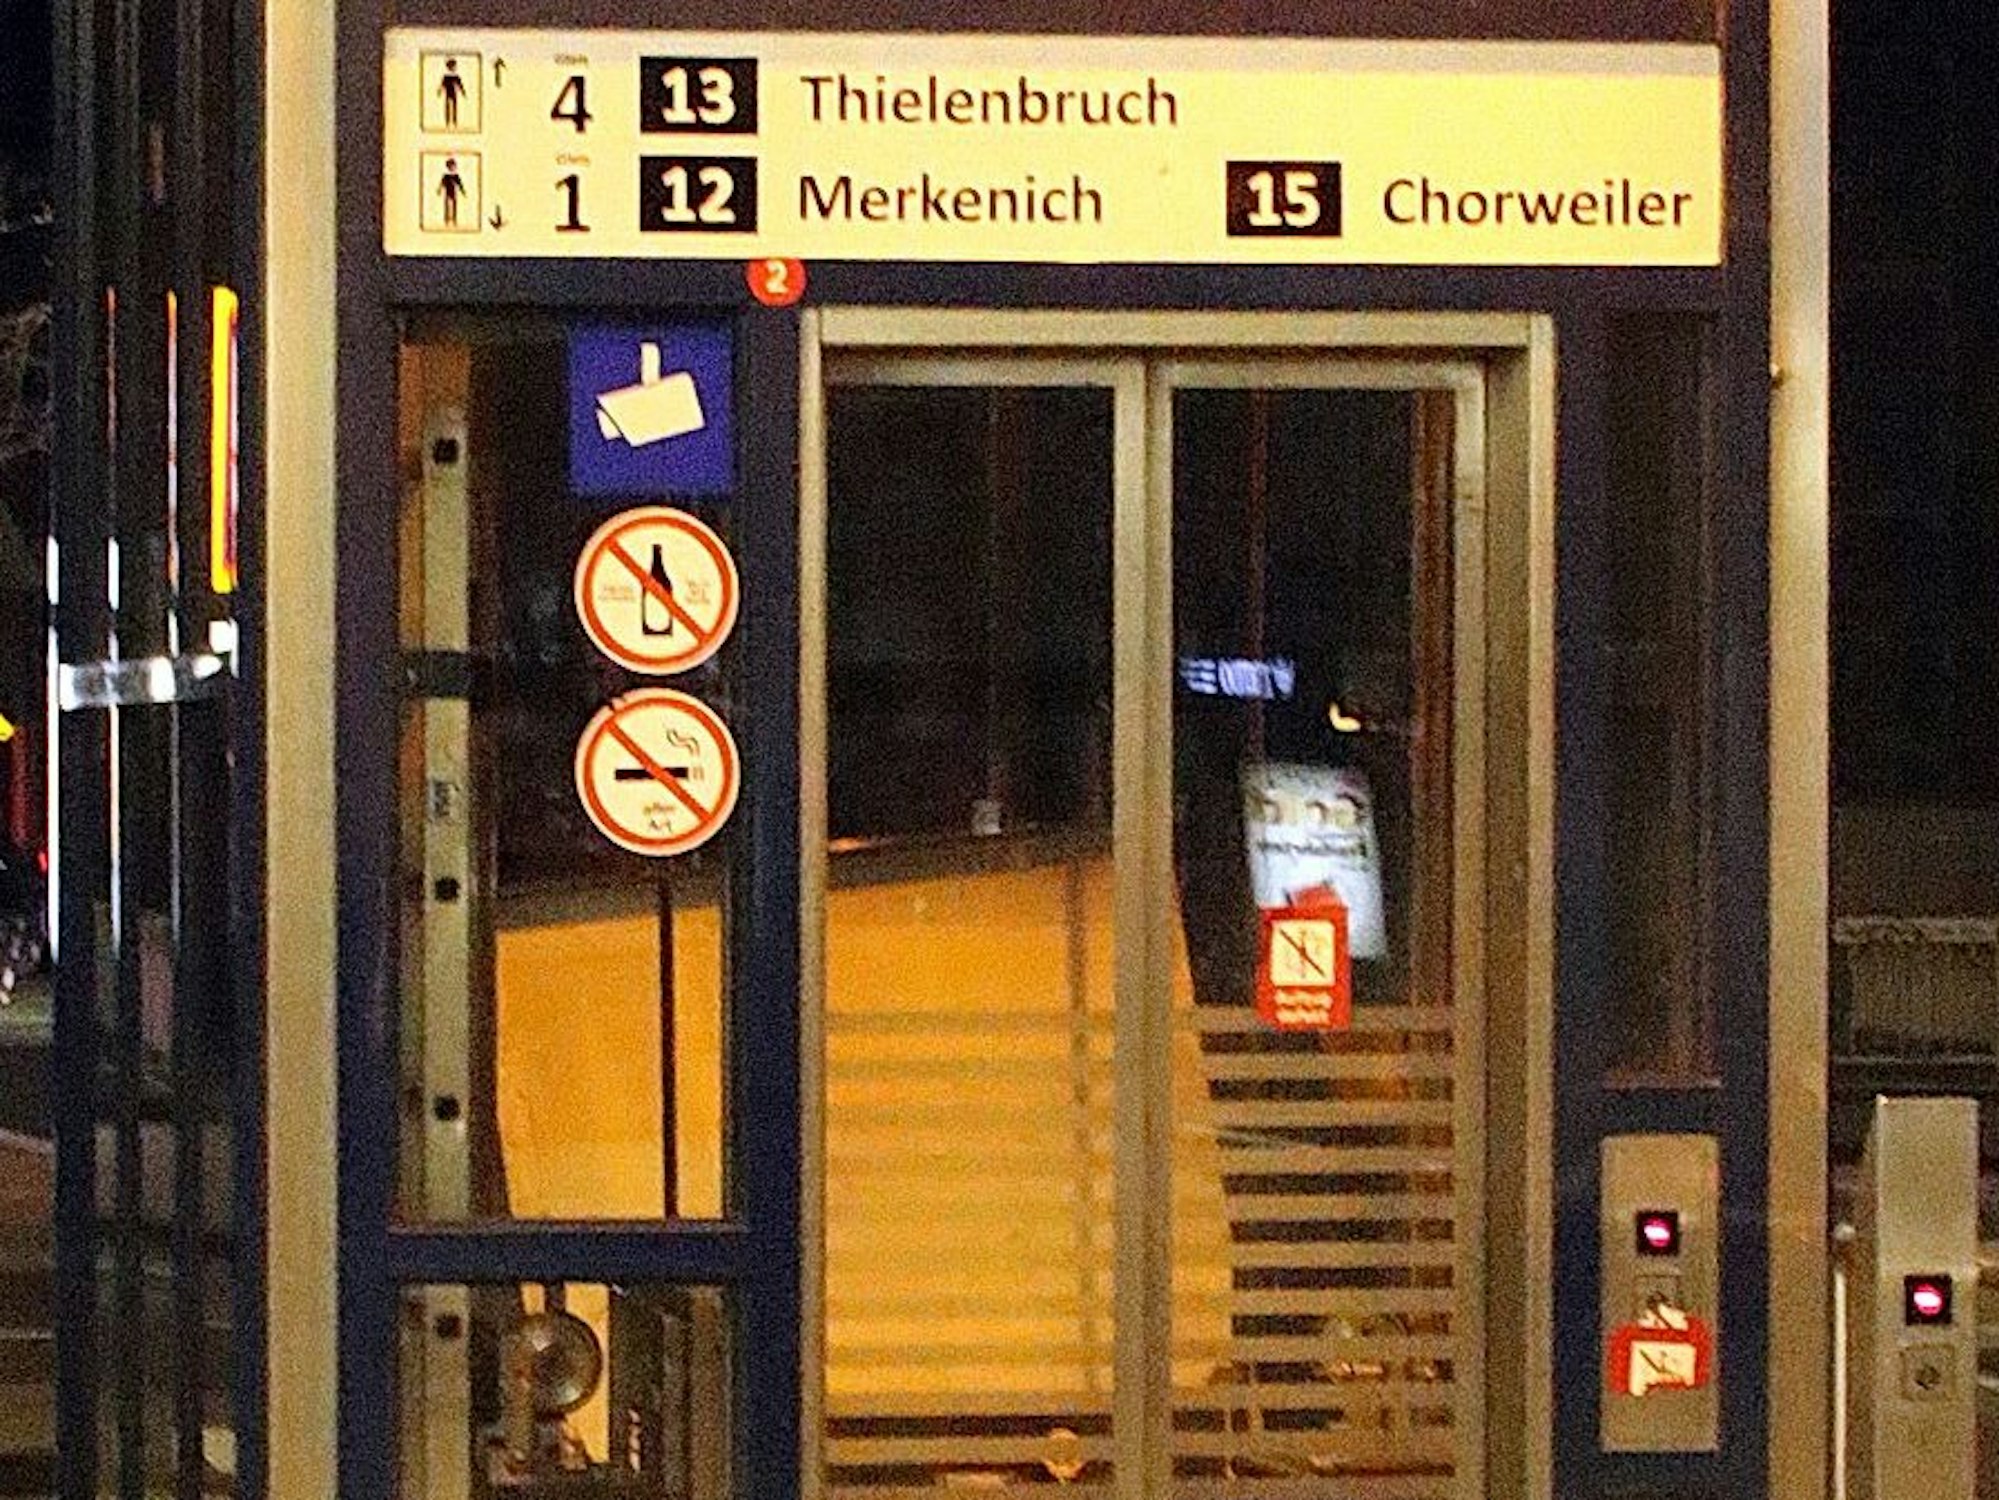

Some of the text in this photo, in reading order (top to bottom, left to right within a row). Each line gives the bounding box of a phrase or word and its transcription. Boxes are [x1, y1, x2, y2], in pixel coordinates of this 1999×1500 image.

[550, 67, 1177, 133] 4 13 Thielenbruch
[554, 166, 1692, 233] 1 12 Merkenich 15 Chorweiler
[766, 261, 788, 293] 2
